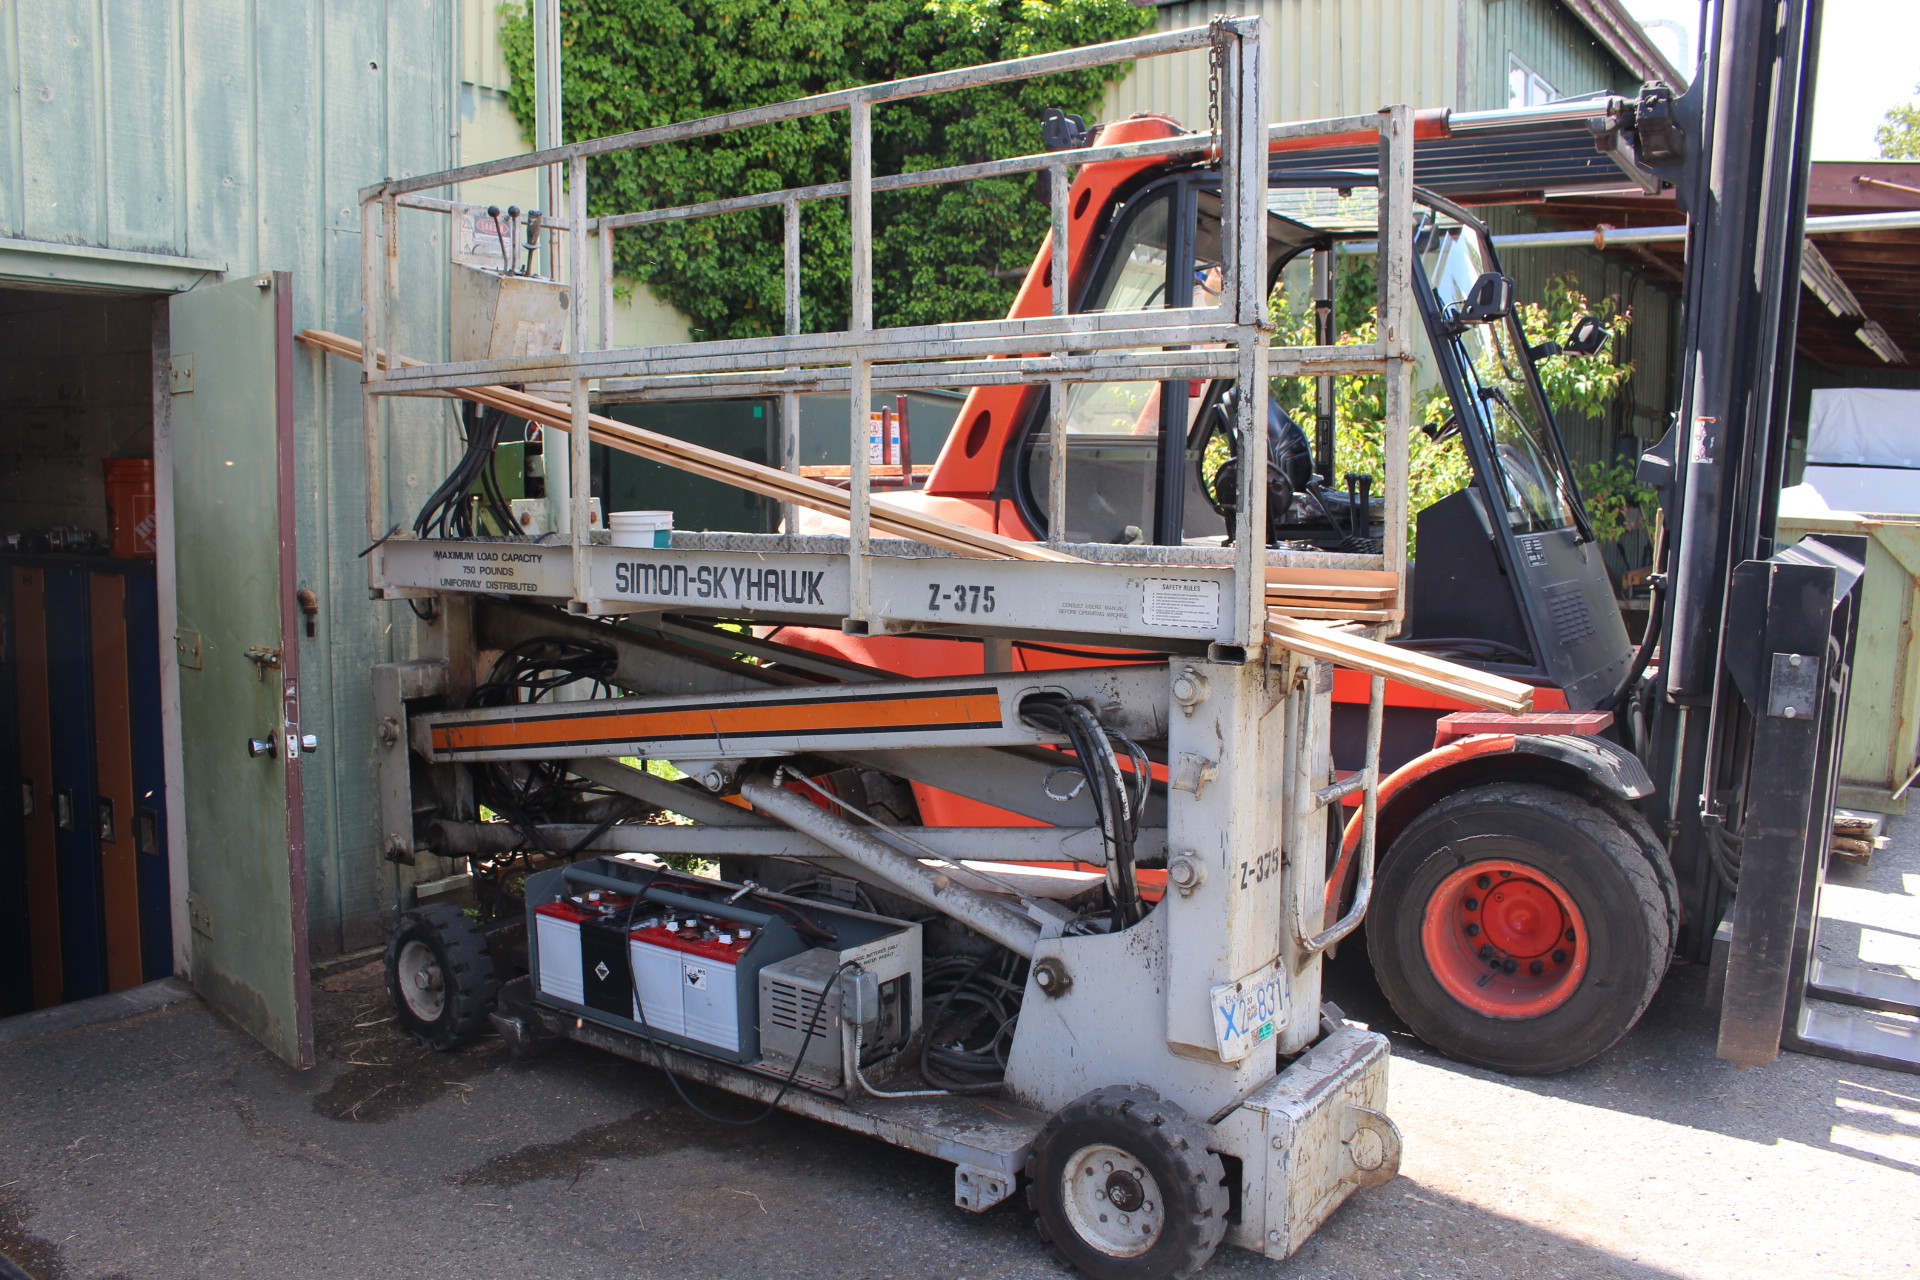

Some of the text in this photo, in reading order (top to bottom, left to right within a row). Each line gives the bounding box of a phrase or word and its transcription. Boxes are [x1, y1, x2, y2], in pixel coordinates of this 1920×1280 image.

[481, 221, 504, 232] DANGR
[434, 551, 542, 563] MAXIMUM LOAD CAPACITY
[463, 566, 514, 576] 750 POUNDS
[440, 578, 537, 592] UNIFORMLY DISTRIBUTED
[616, 562, 824, 605] SIMON-SKYHAWK
[1162, 583, 1182, 591] SAFETY
[929, 583, 995, 613] Z-375
[1241, 847, 1279, 890] Z-375
